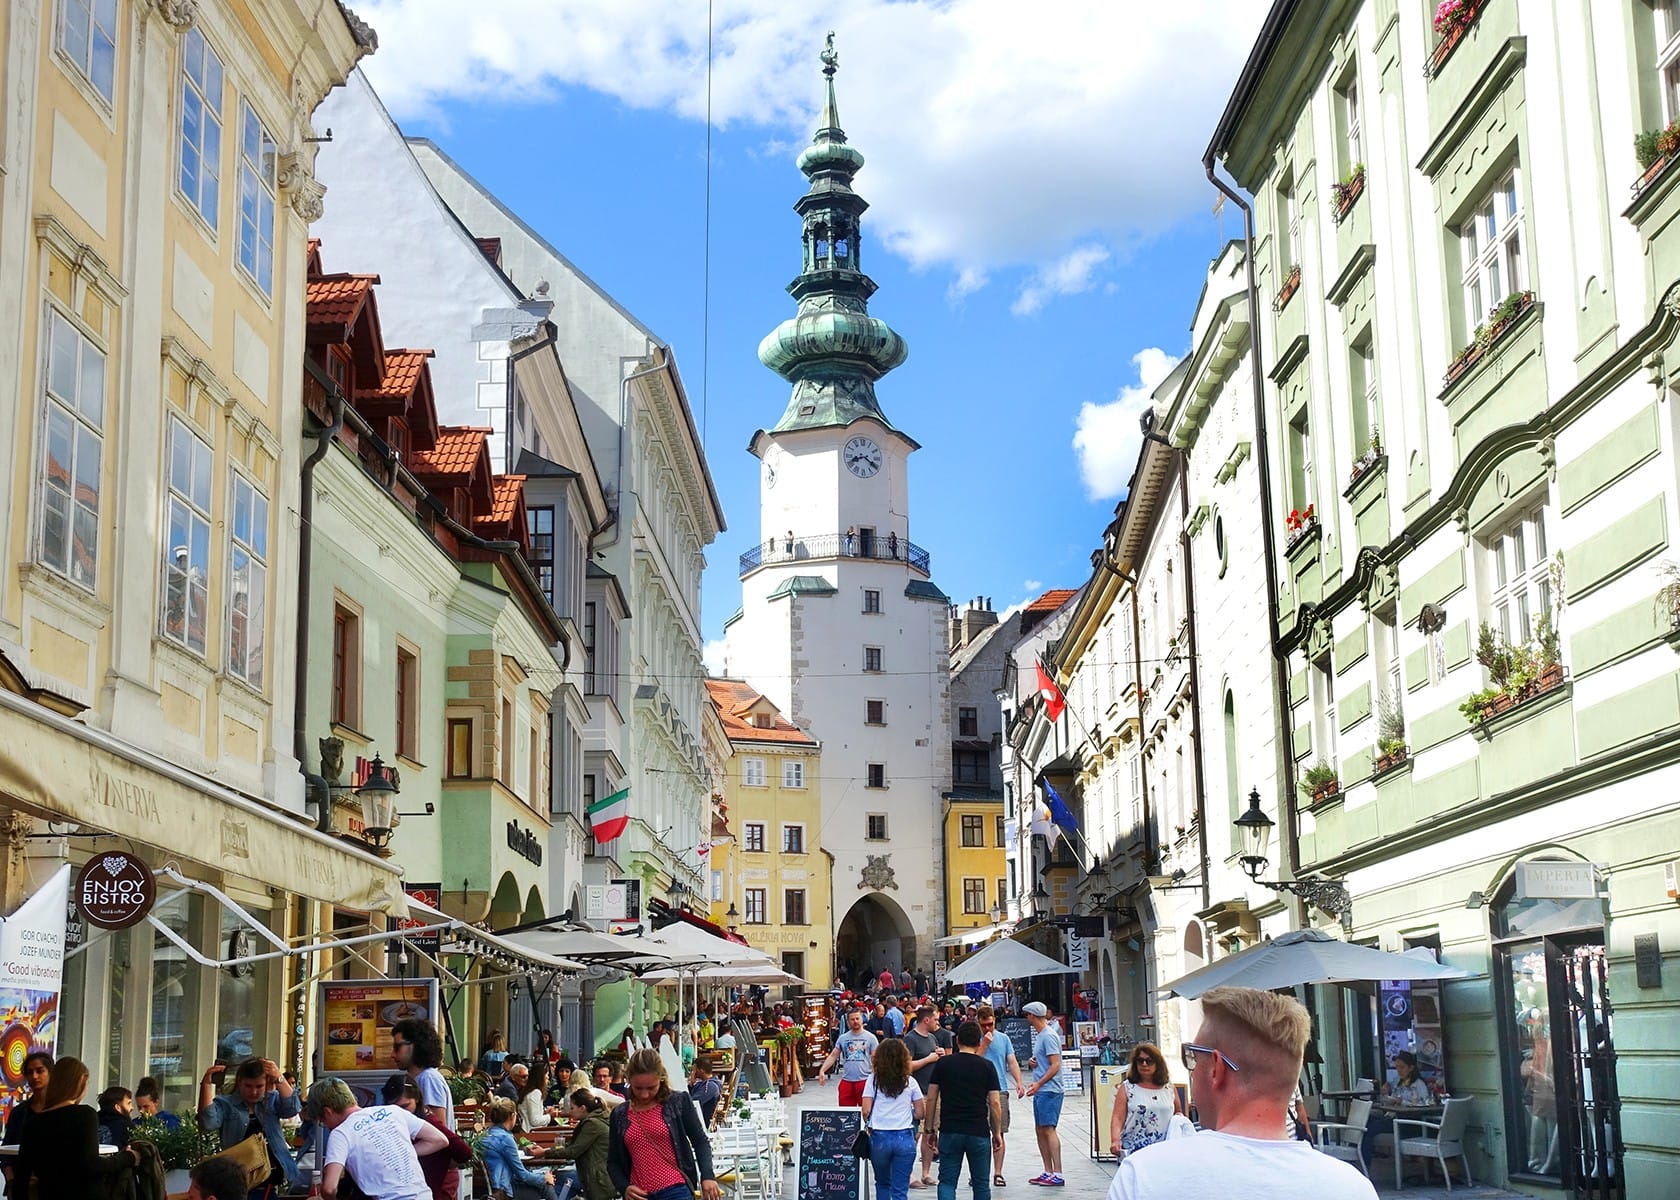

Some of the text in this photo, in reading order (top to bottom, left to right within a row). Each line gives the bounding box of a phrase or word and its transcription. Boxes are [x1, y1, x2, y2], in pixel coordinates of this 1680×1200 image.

[89, 771, 161, 824] MINERVA
[83, 880, 145, 893] ENJOY
[83, 893, 145, 905] BISTRO
